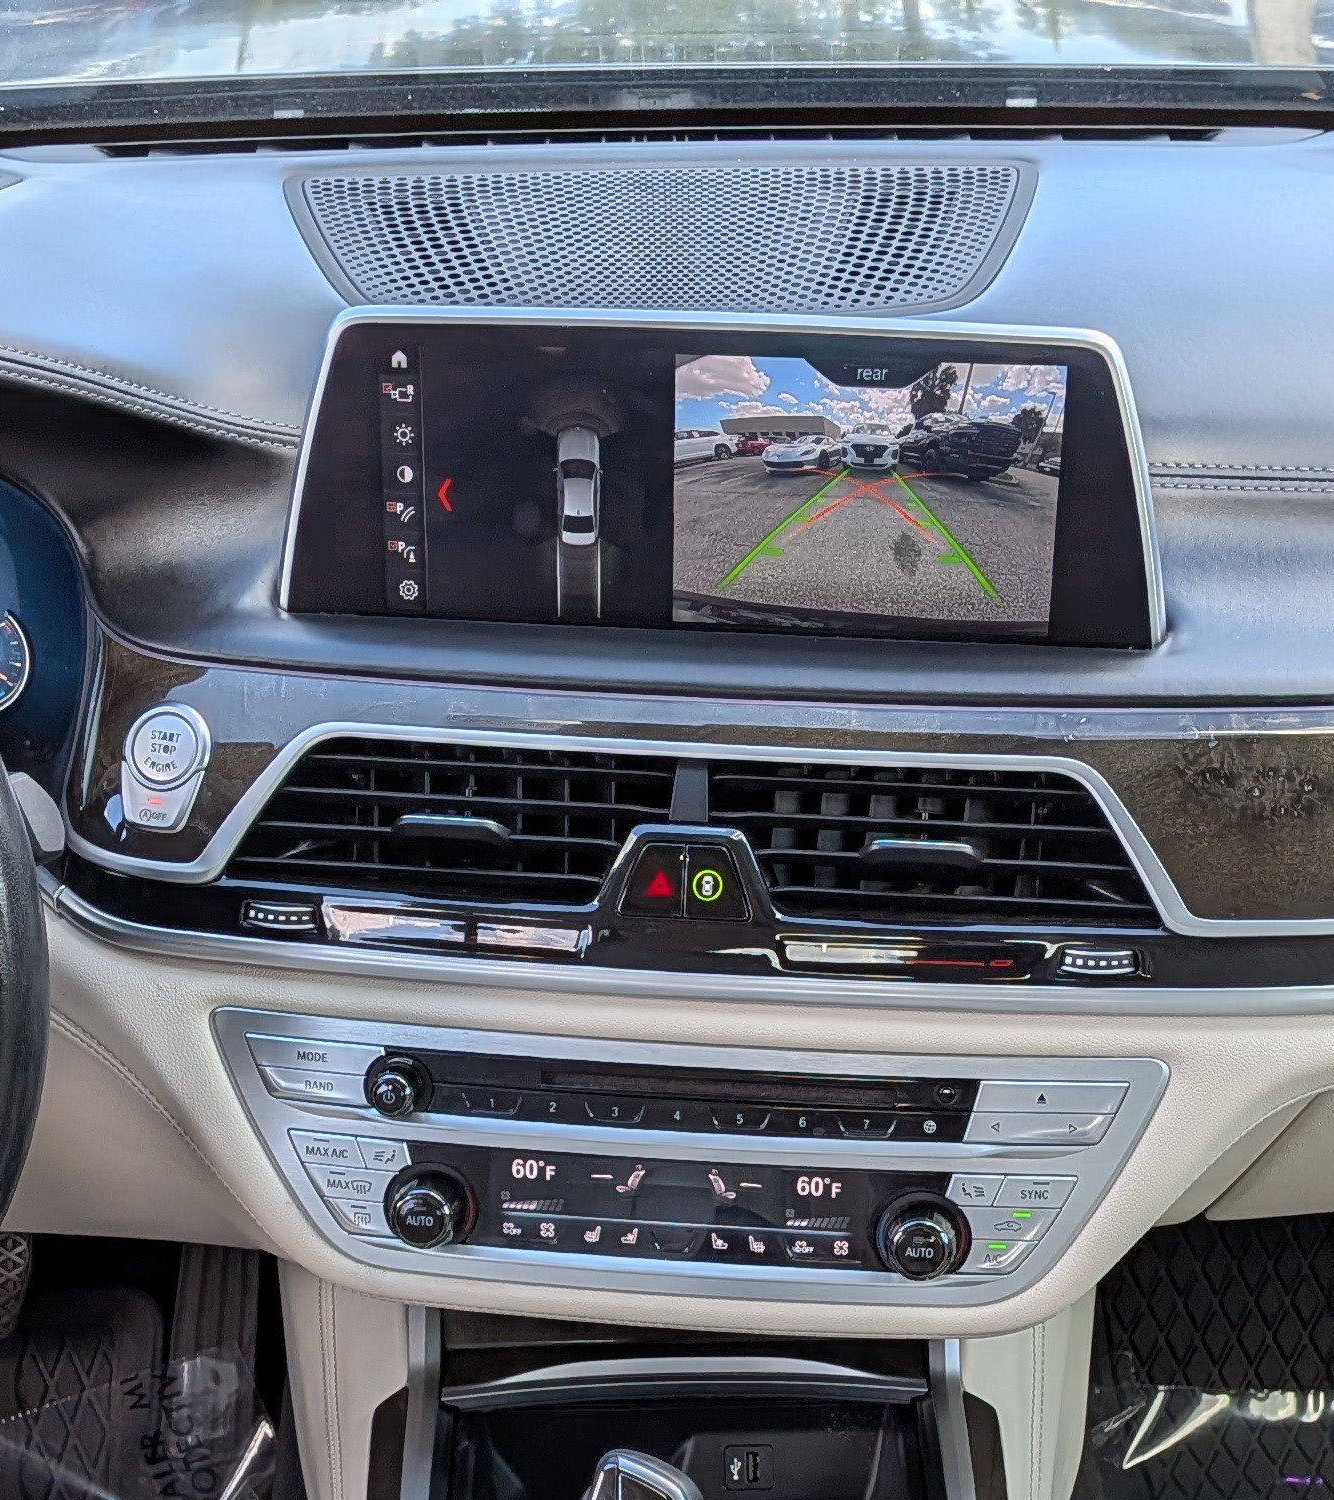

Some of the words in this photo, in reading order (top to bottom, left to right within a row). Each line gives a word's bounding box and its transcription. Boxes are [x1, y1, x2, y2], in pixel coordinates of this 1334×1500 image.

[856, 367, 889, 381] rear
[150, 729, 182, 744] START
[150, 742, 177, 756] STOP
[143, 756, 179, 773] ENGINE
[151, 811, 168, 821] OFF
[296, 1049, 328, 1063] MODE
[304, 1079, 334, 1092] BAND
[489, 1098, 495, 1109] 1
[548, 1102, 557, 1113] 2
[611, 1106, 619, 1118] 3
[673, 1110, 681, 1122] 4
[736, 1113, 744, 1125] 5
[798, 1116, 806, 1128] 6
[862, 1119, 870, 1131] 7
[305, 1145, 329, 1158] MAX
[331, 1147, 349, 1159] A/C
[511, 1158, 557, 1181] 60°F
[327, 1178, 351, 1190] MAX
[796, 1175, 842, 1199] 60°F
[1020, 1189, 1050, 1200] SYNC
[405, 1215, 434, 1227] AUTO
[904, 1246, 934, 1259] AUTO
[983, 1253, 1002, 1264] A/C
